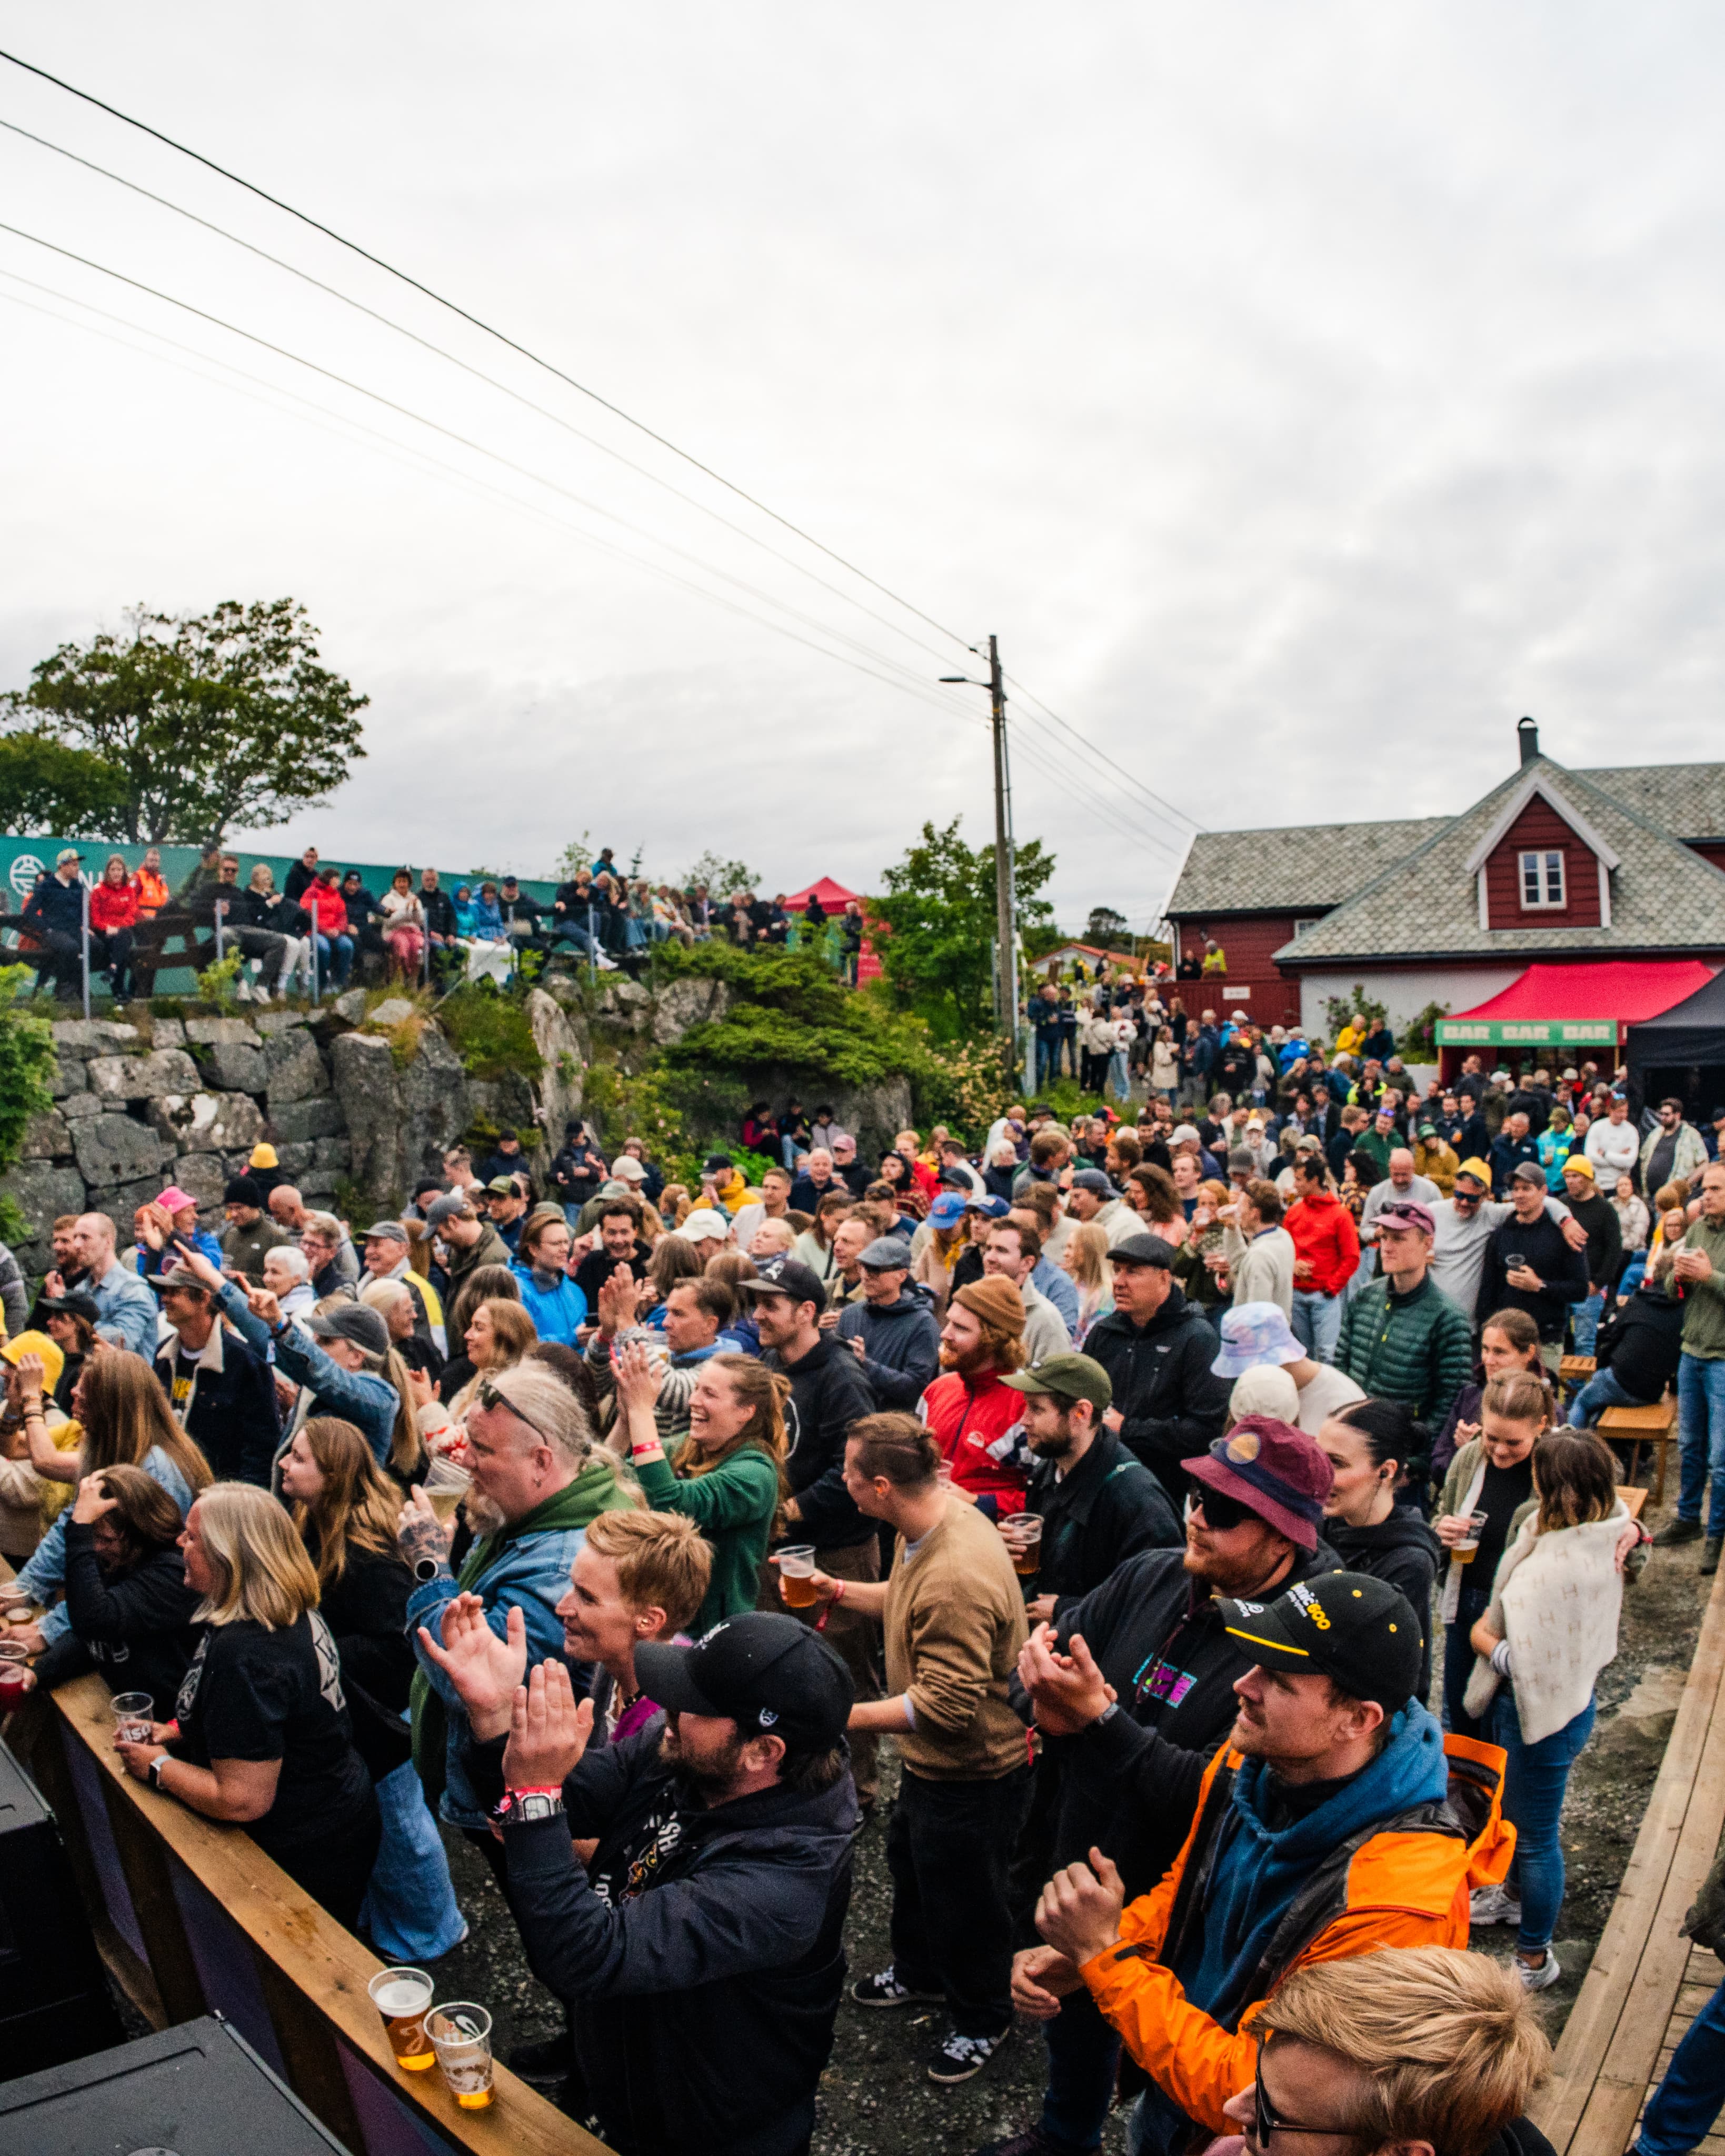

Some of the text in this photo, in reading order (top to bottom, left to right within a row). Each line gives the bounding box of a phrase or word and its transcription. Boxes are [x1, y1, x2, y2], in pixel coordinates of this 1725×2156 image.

[1443, 1025, 1489, 1040] BAR
[1502, 1025, 1549, 1040] BAR
[1562, 1025, 1610, 1040] BAR
